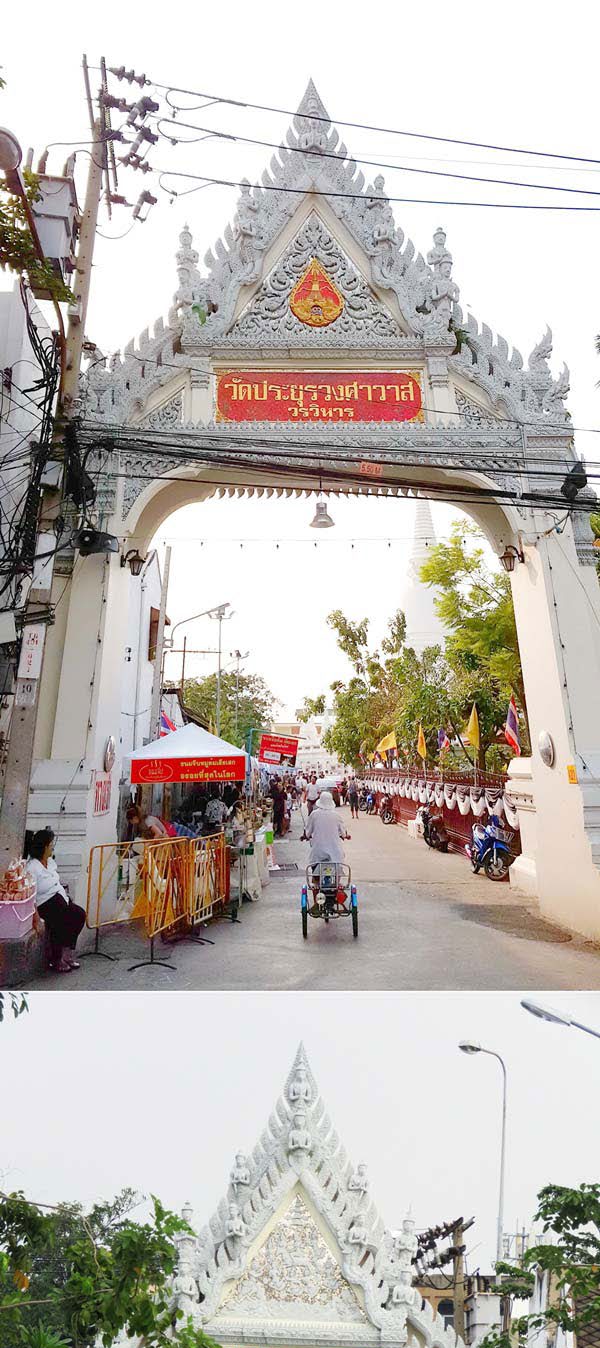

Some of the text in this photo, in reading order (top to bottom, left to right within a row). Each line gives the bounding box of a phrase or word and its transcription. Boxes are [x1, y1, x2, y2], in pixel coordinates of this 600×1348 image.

[224, 376, 415, 406] วัดประยุรวงศาวาส
[287, 404, 355, 418] วรวิหาร
